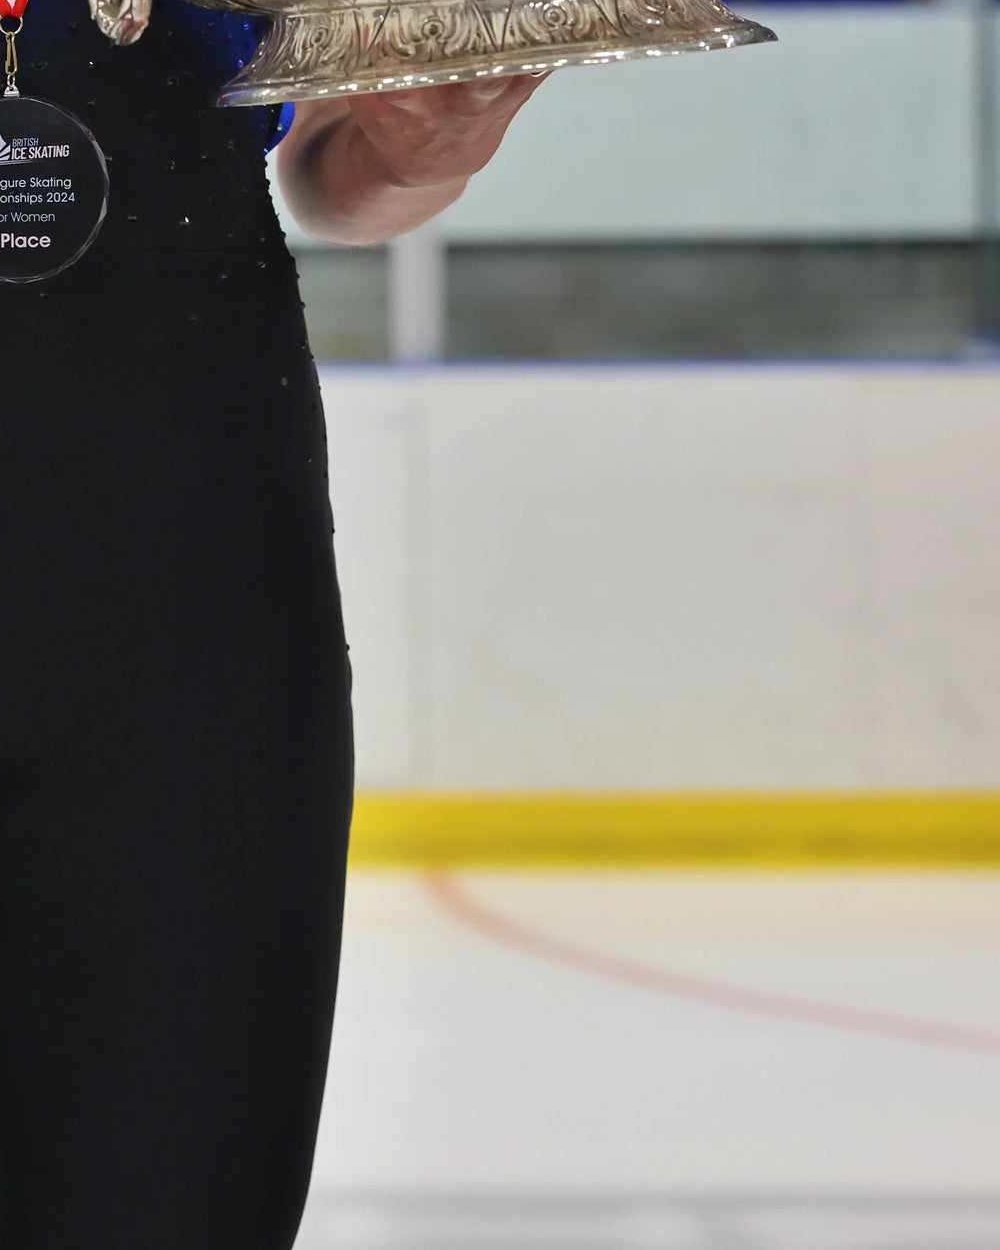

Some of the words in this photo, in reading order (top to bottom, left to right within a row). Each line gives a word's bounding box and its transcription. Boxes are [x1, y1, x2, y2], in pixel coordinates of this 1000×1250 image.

[12, 137, 39, 148] BRITISH
[11, 147, 26, 160] ICE
[28, 145, 70, 159] SKATING
[29, 177, 72, 190] Skating
[46, 192, 76, 203] 2024
[10, 212, 56, 223] Women
[0, 233, 51, 248] Place
